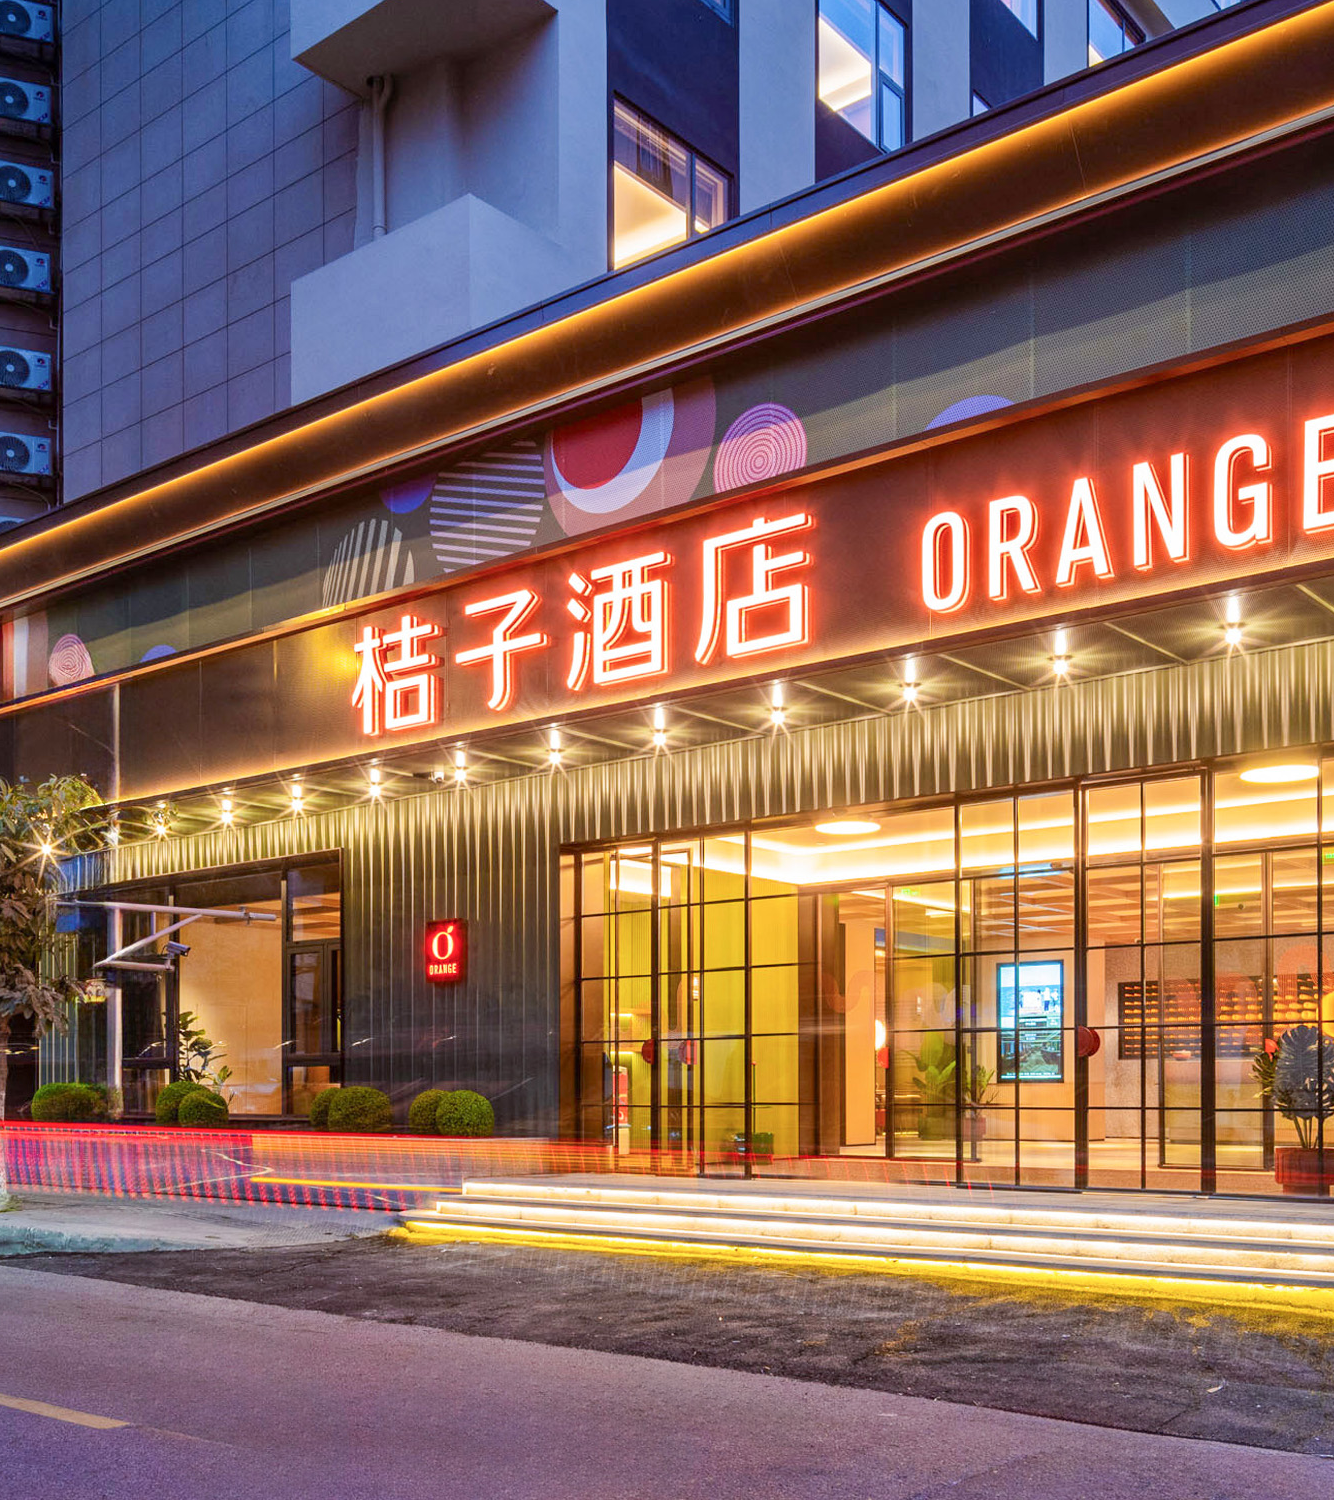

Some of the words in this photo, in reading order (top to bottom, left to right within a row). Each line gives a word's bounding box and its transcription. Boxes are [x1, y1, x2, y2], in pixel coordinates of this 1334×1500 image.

[351, 512, 814, 736] 桔子酒店
[429, 963, 457, 975] ORANGE
